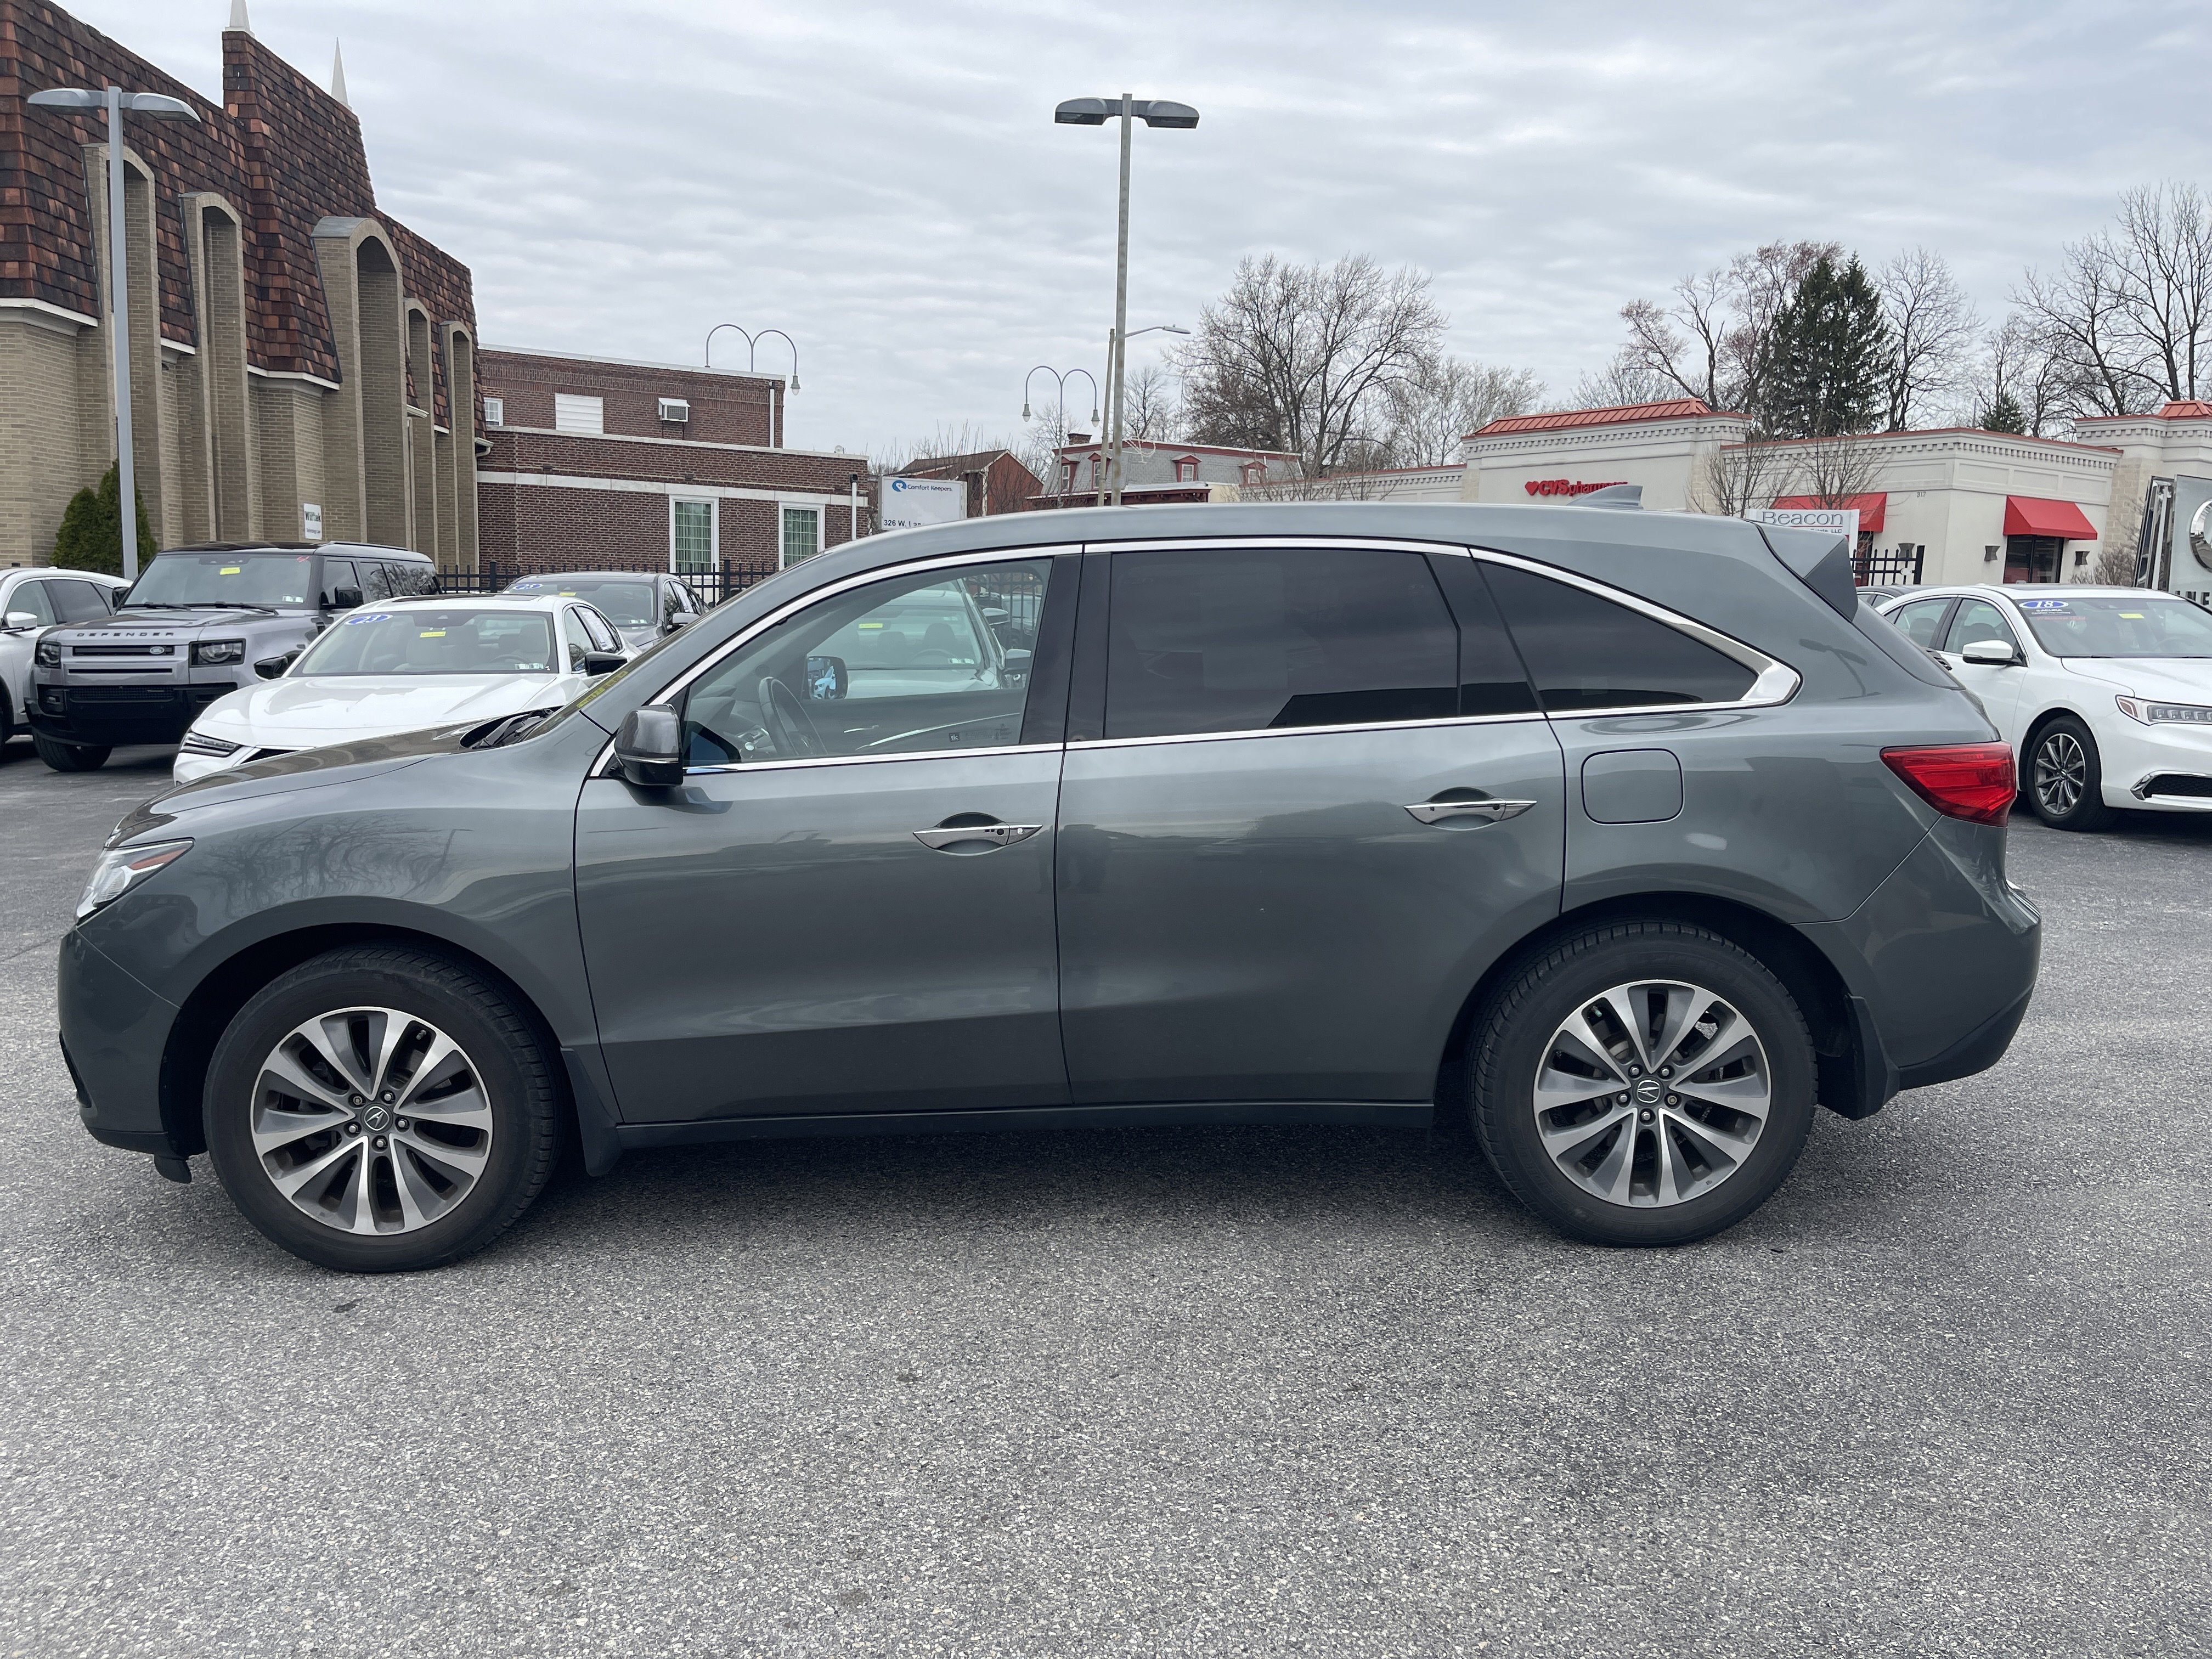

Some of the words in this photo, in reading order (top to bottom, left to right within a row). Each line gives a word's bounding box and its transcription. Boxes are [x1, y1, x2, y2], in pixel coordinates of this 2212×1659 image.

[1539, 479, 1569, 495] CVS
[1569, 481, 1628, 496] pharm
[1762, 511, 1843, 525] Beacon
